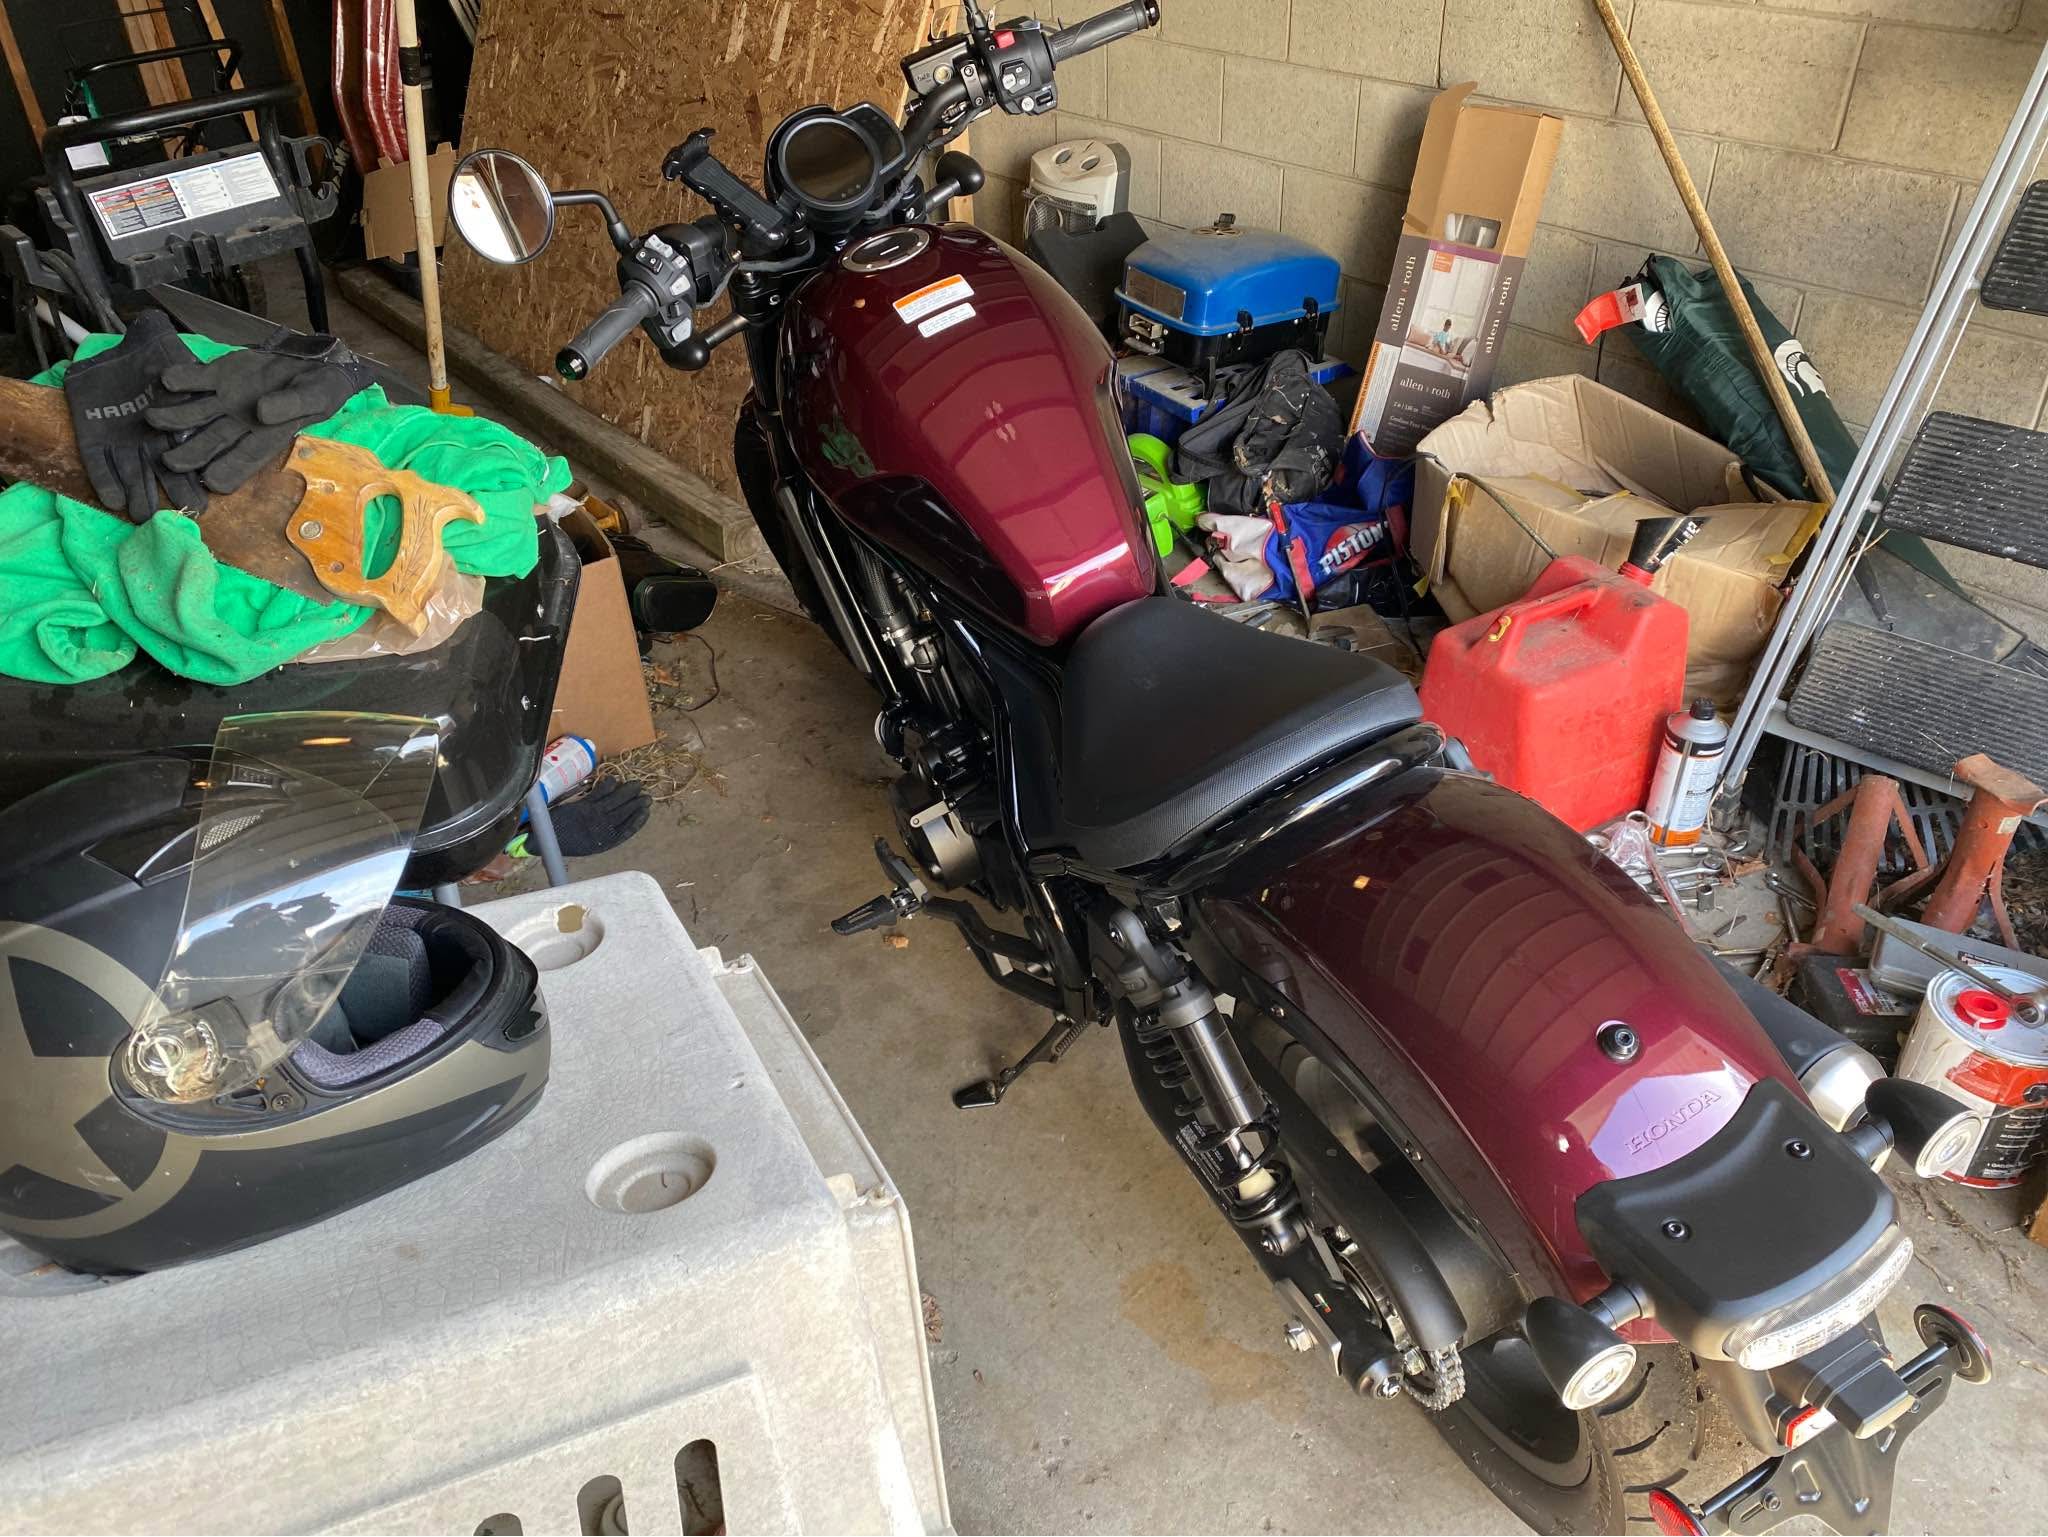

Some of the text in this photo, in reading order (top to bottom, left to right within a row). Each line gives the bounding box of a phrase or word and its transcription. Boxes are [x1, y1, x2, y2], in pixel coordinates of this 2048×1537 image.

[1391, 256, 1417, 332] allen roth
[1486, 276, 1512, 354] allen roth
[1400, 377, 1451, 399] allen roth
[1319, 521, 1388, 576] PISTON
[1625, 1089, 1721, 1155] HONDA
